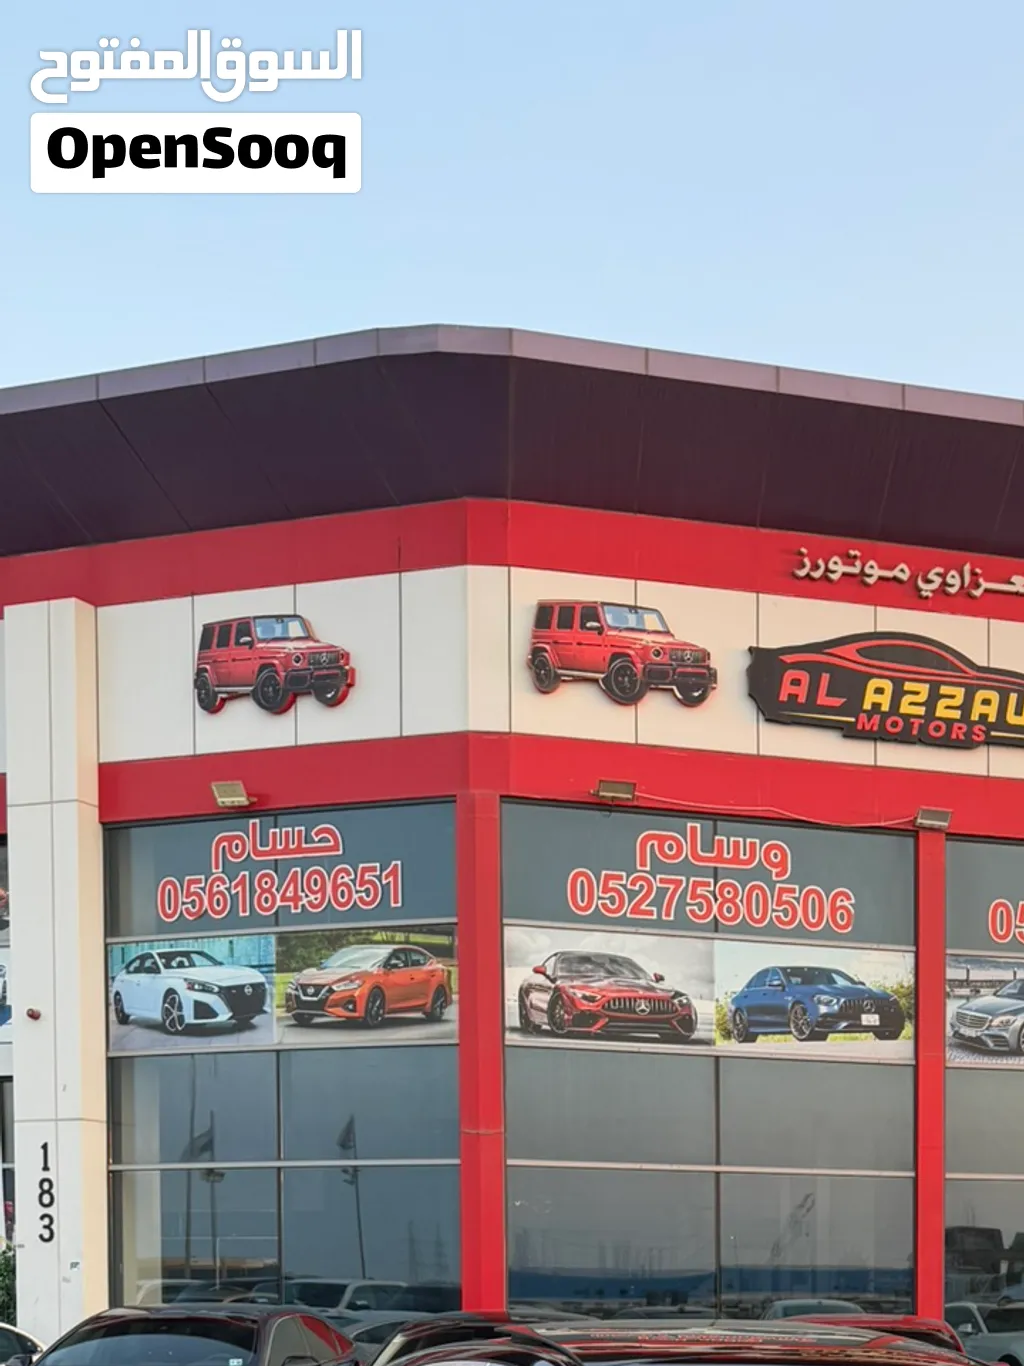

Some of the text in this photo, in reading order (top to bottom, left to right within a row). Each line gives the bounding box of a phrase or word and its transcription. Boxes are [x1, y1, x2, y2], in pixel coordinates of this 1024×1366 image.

[792, 547, 911, 585] موتورز
[779, 669, 848, 707] AL
[856, 713, 987, 742] MOTORS
[211, 818, 343, 873] حسام
[635, 821, 792, 882] وسام
[156, 859, 403, 924] 0561849651
[566, 867, 856, 934] 0527580506
